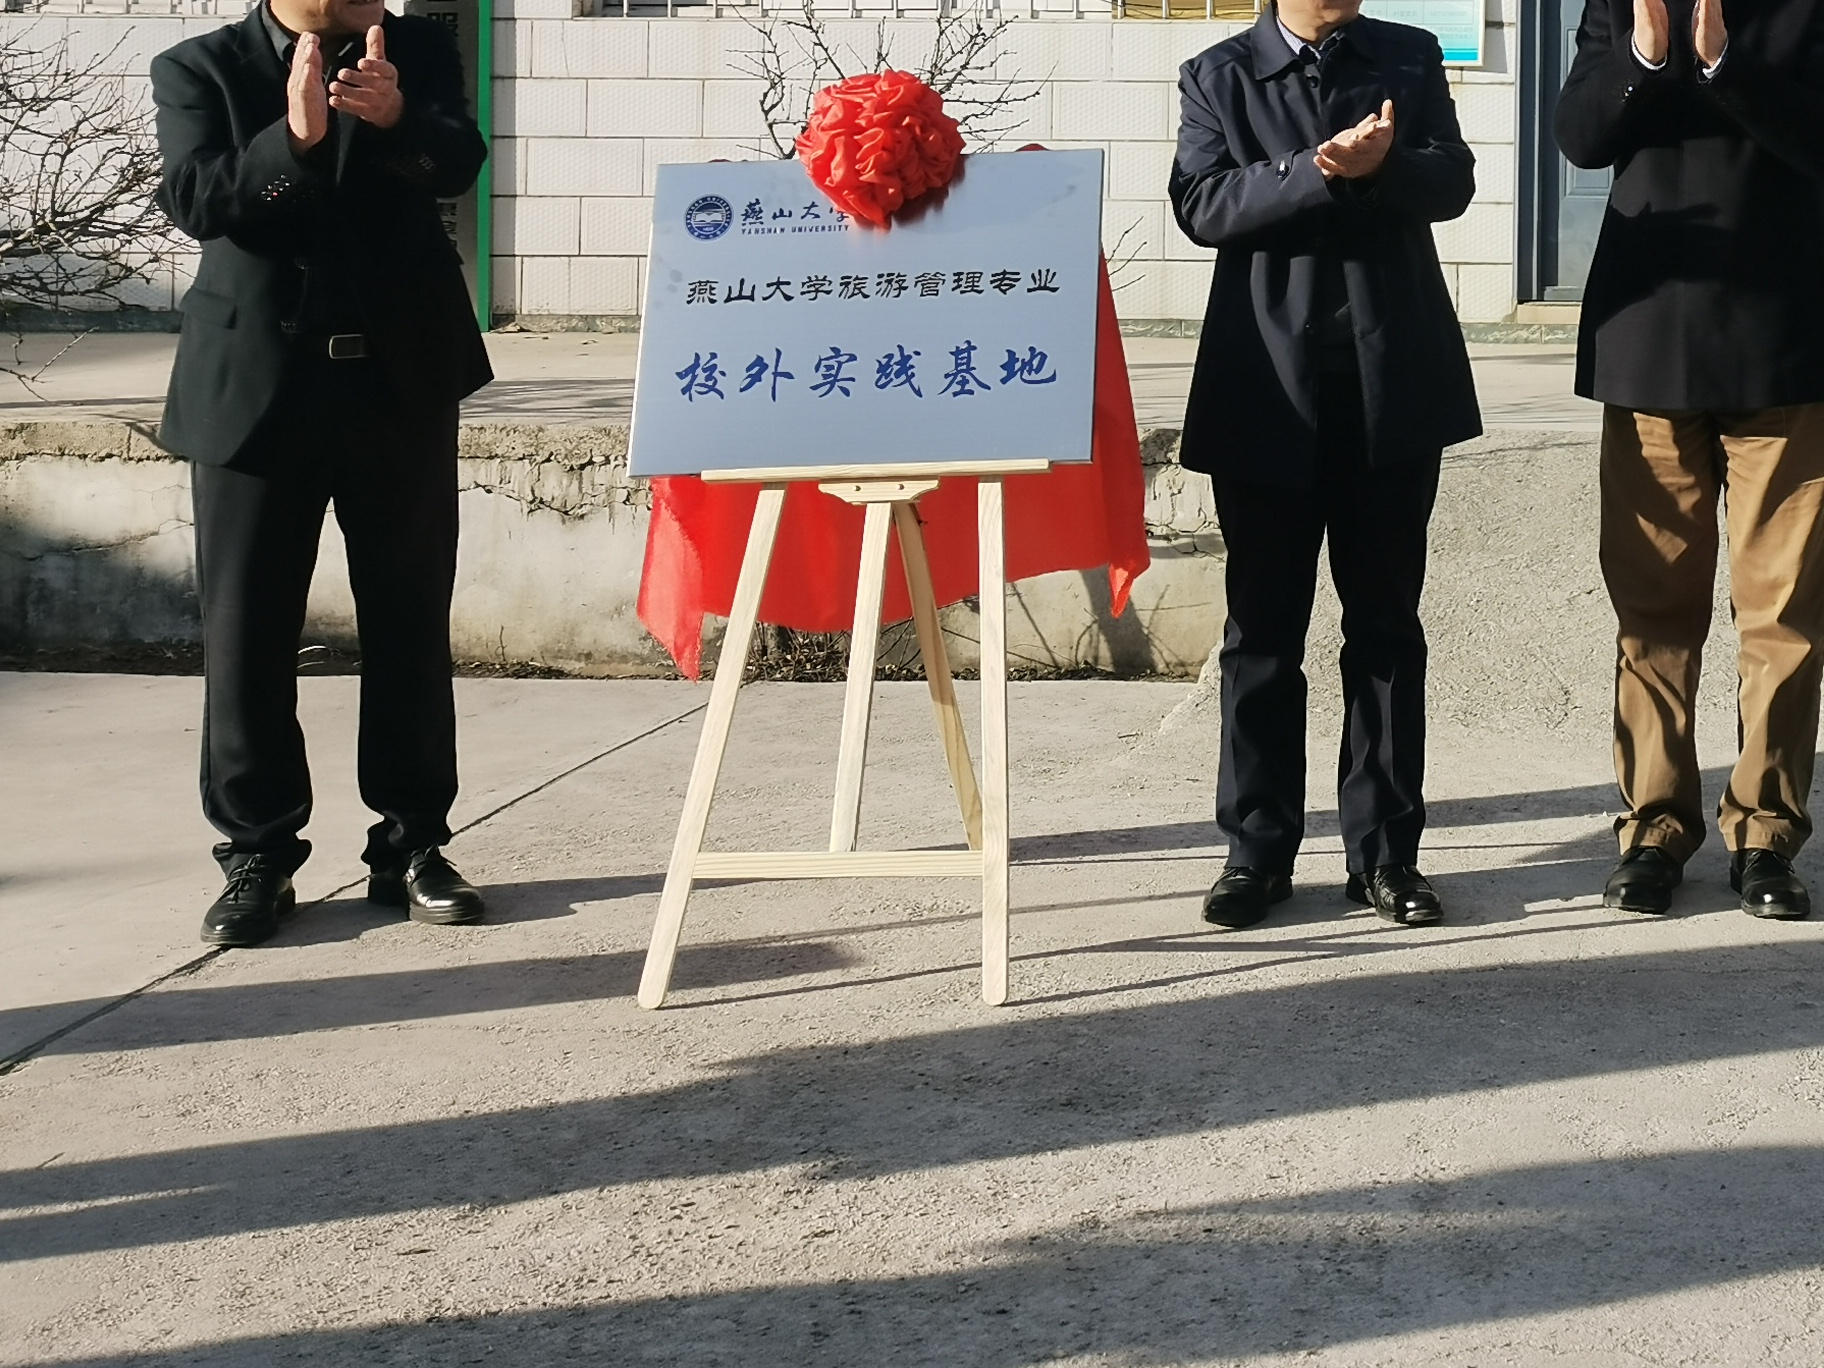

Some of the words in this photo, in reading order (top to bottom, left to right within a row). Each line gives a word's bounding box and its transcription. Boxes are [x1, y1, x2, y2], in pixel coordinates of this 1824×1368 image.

[741, 227, 785, 235] YANSHAN
[791, 224, 850, 234] UNIVERSITY
[685, 268, 1061, 305] 燕山大学旅游管理专业
[675, 340, 1057, 403] 校外实践基地
